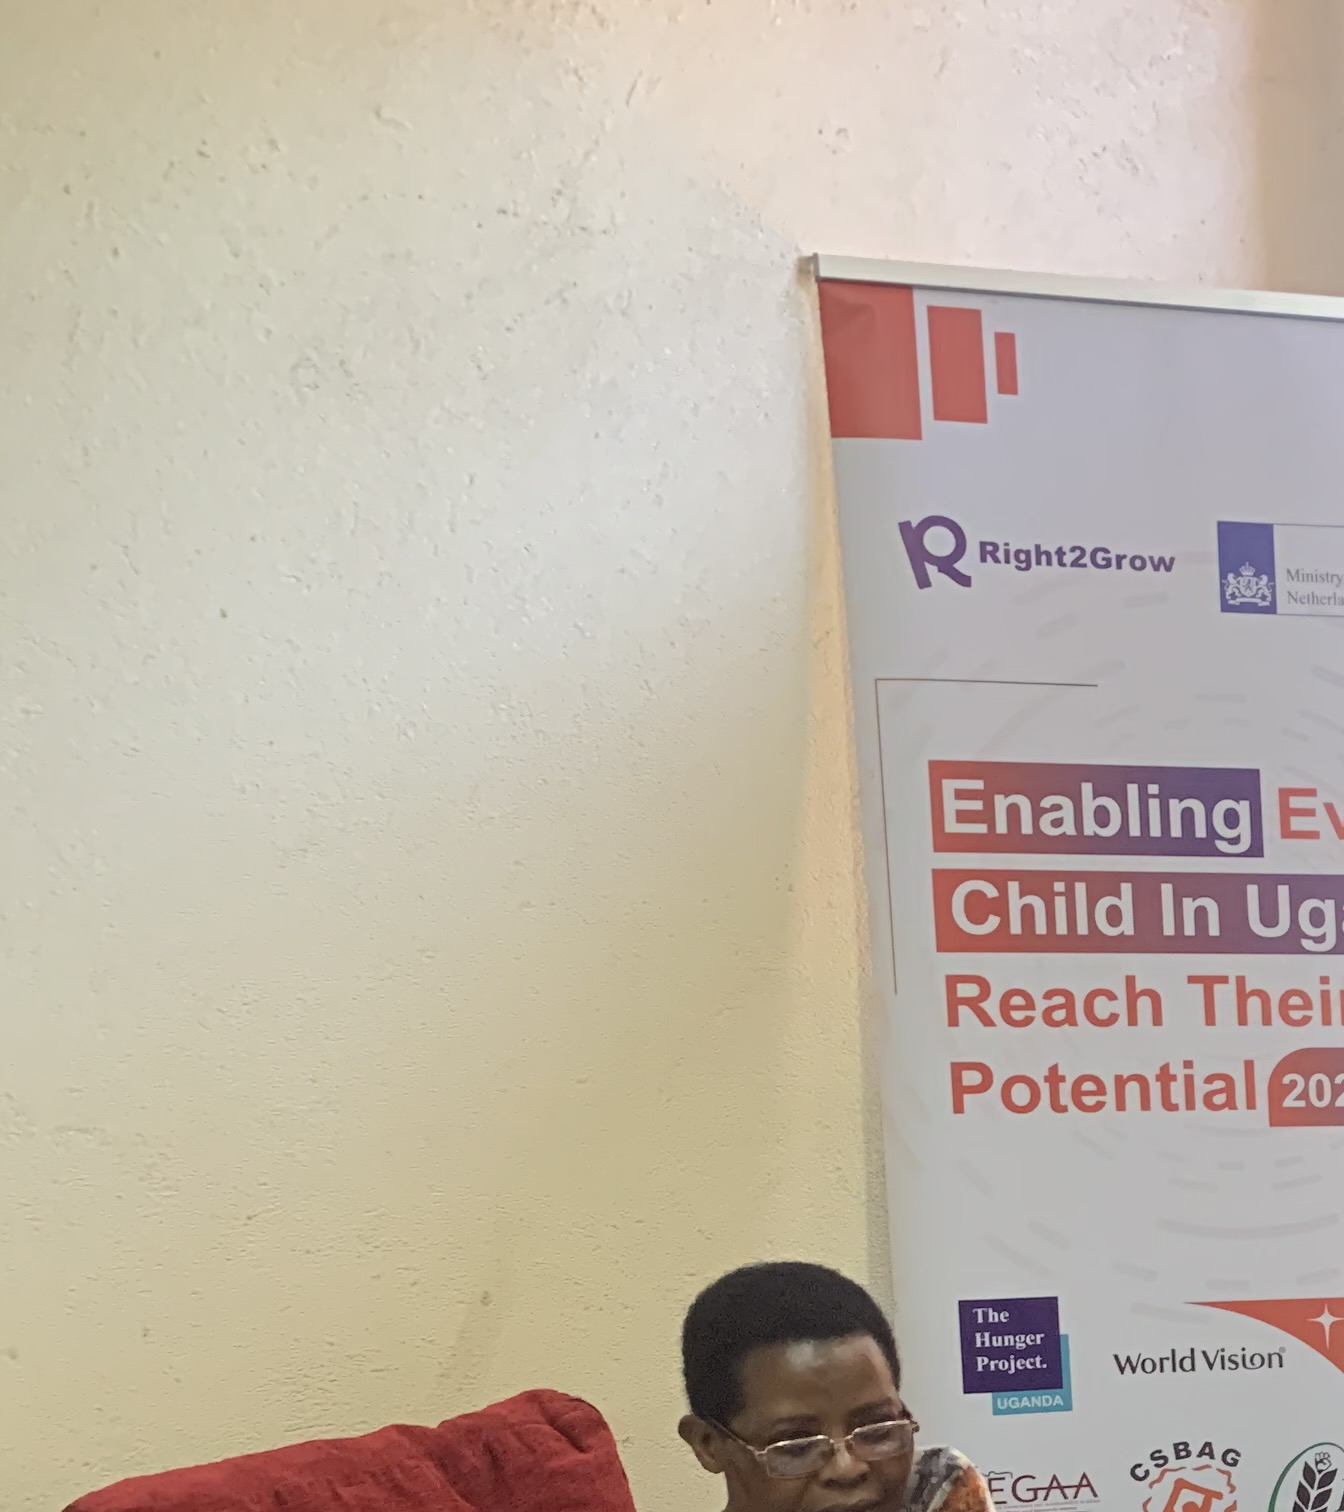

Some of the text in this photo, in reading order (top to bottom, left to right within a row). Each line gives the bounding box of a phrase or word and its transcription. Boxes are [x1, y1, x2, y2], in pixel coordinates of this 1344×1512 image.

[978, 540, 1176, 573] Right2Grow
[1285, 568, 1344, 587] Ministry
[942, 779, 1254, 853] Enabling
[951, 880, 1135, 938] Child
[1162, 882, 1221, 938] In
[945, 974, 1164, 1028] Reach
[950, 1059, 1258, 1115] Potential
[972, 1307, 1010, 1324] The
[975, 1331, 1045, 1350] Hunger
[976, 1354, 1048, 1374] Project.
[1112, 1347, 1284, 1376] World Vision
[997, 1395, 1064, 1409] UGANDA
[1130, 1441, 1241, 1482] CSBAG
[987, 1471, 1099, 1504] EGAA
